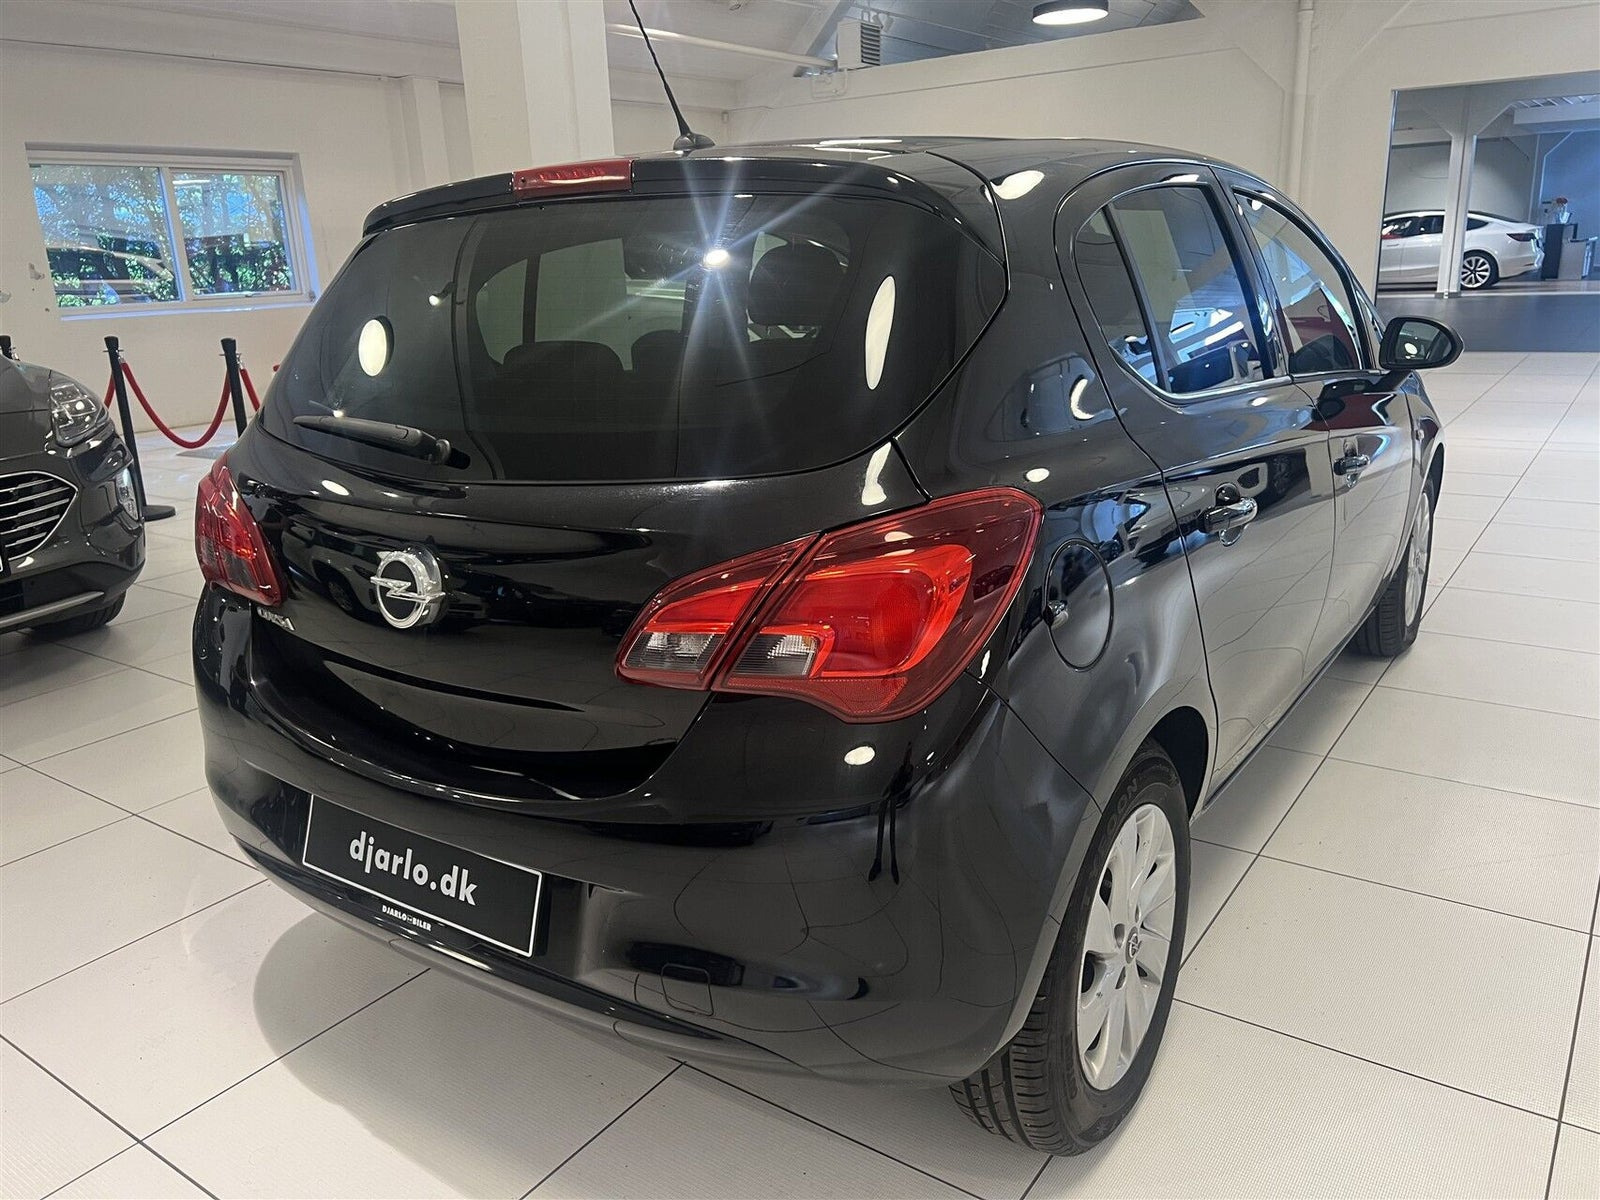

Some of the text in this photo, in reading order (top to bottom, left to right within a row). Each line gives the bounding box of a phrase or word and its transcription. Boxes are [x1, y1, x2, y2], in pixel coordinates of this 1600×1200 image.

[349, 830, 478, 906] djarlo.dk
[382, 904, 432, 931] DJARLO BILER
